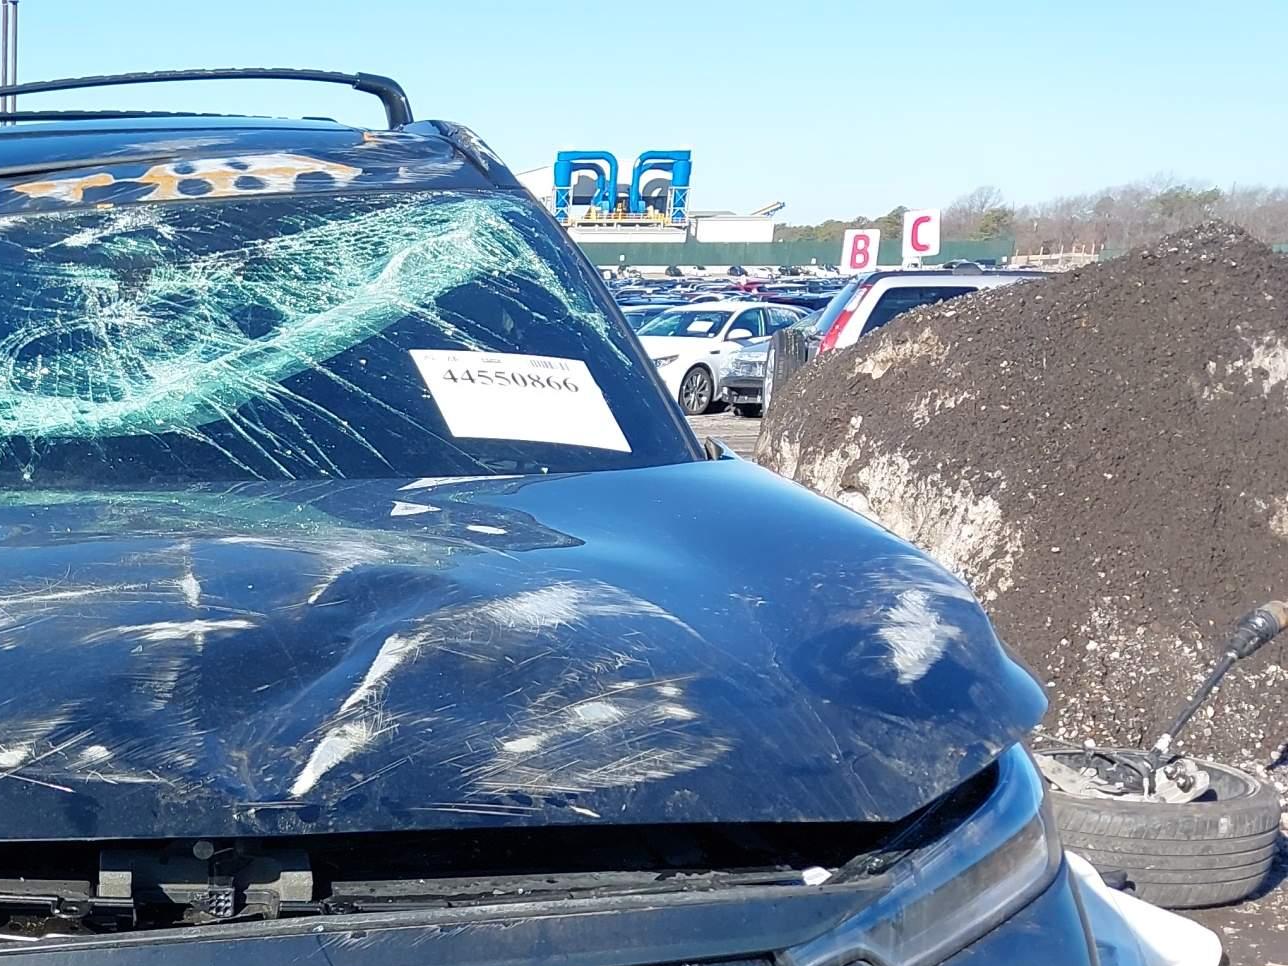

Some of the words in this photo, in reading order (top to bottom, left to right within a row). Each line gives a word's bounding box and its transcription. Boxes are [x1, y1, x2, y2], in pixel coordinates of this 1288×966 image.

[850, 234, 870, 269] B
[911, 216, 931, 252] C
[442, 368, 580, 393] 44550866
